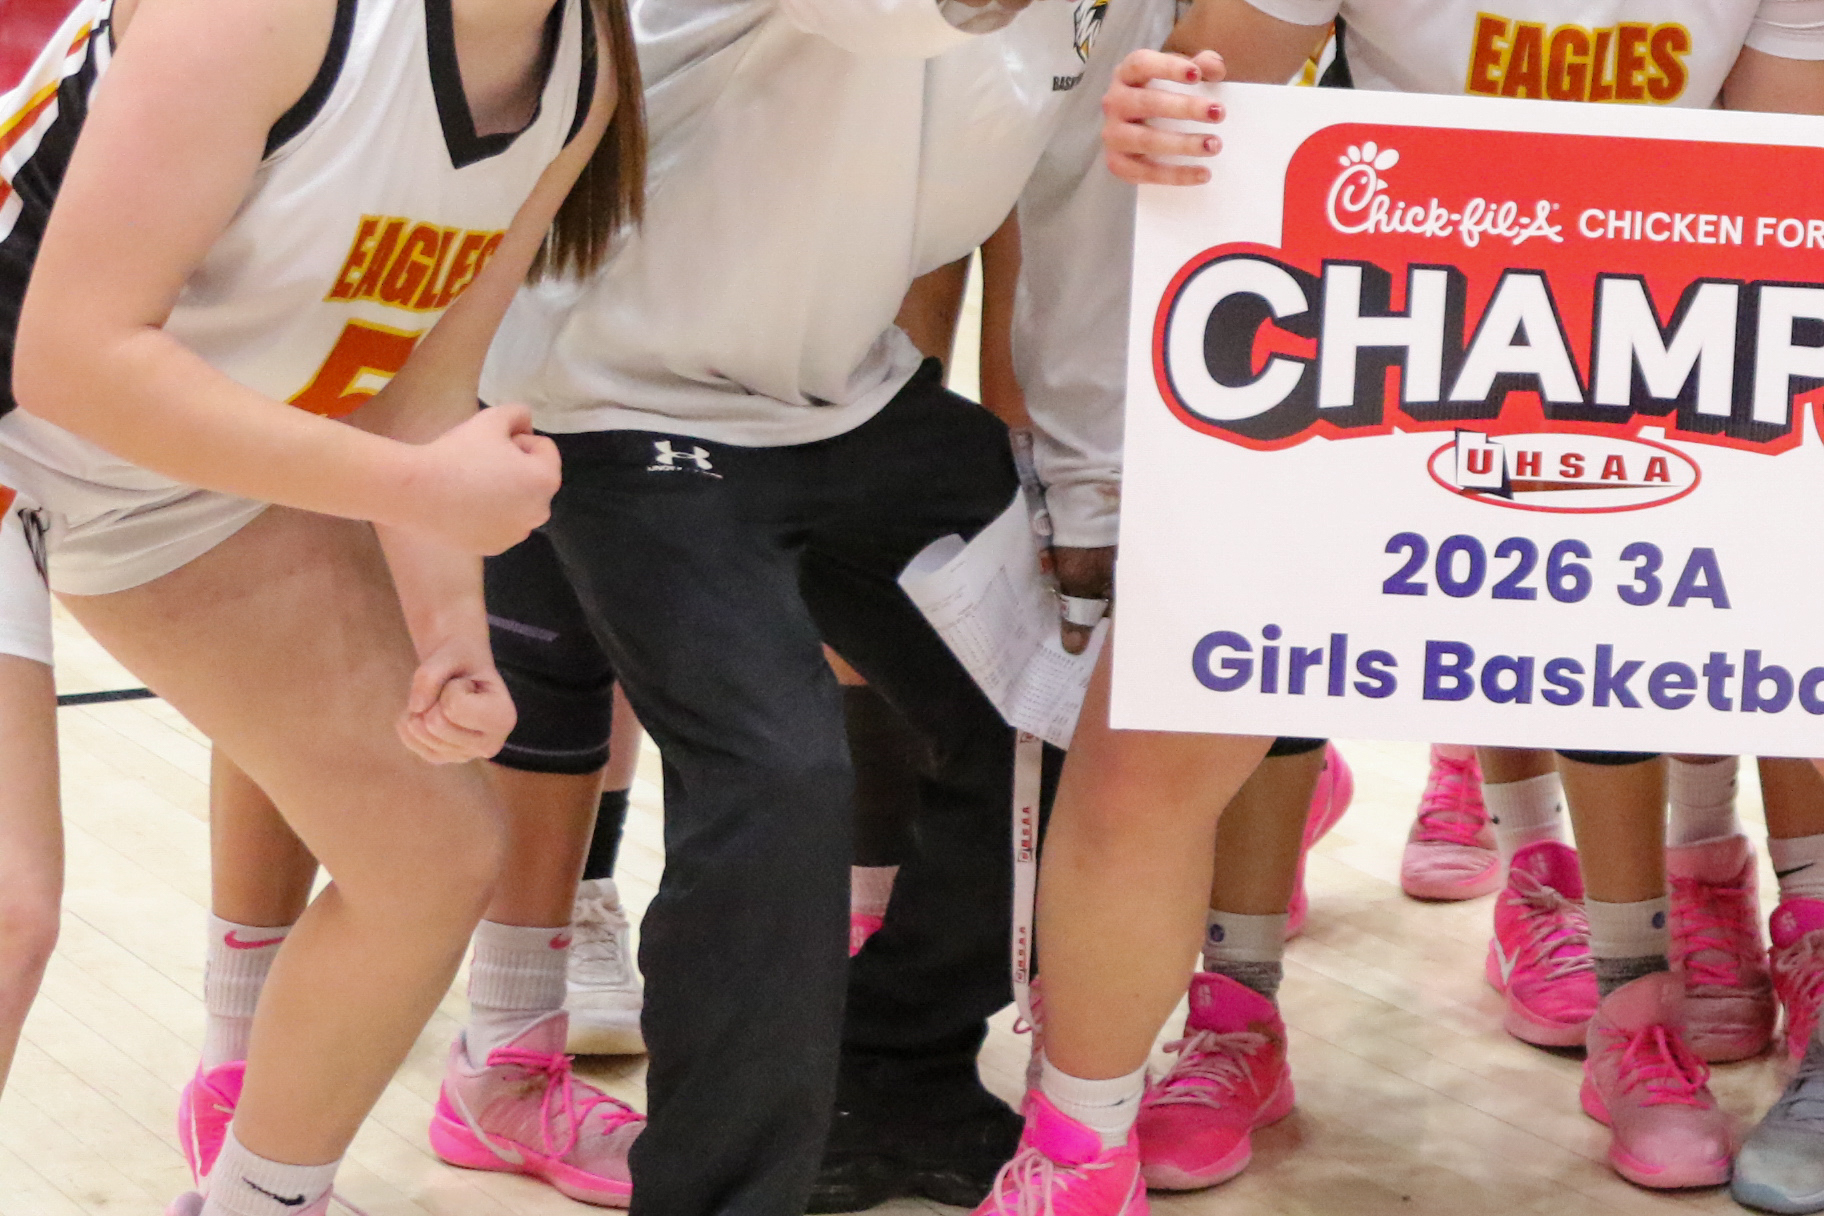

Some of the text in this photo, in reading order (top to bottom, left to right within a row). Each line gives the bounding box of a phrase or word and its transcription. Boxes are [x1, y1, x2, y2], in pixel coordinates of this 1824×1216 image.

[1465, 12, 1692, 105] EAGLES
[1325, 162, 1564, 248] Chick-fil-A
[1578, 207, 1743, 245] CHICKEN
[1466, 448, 1671, 483] UHSAA
[1382, 531, 1733, 610] 2026 3A
[1191, 623, 1399, 701] Girls
